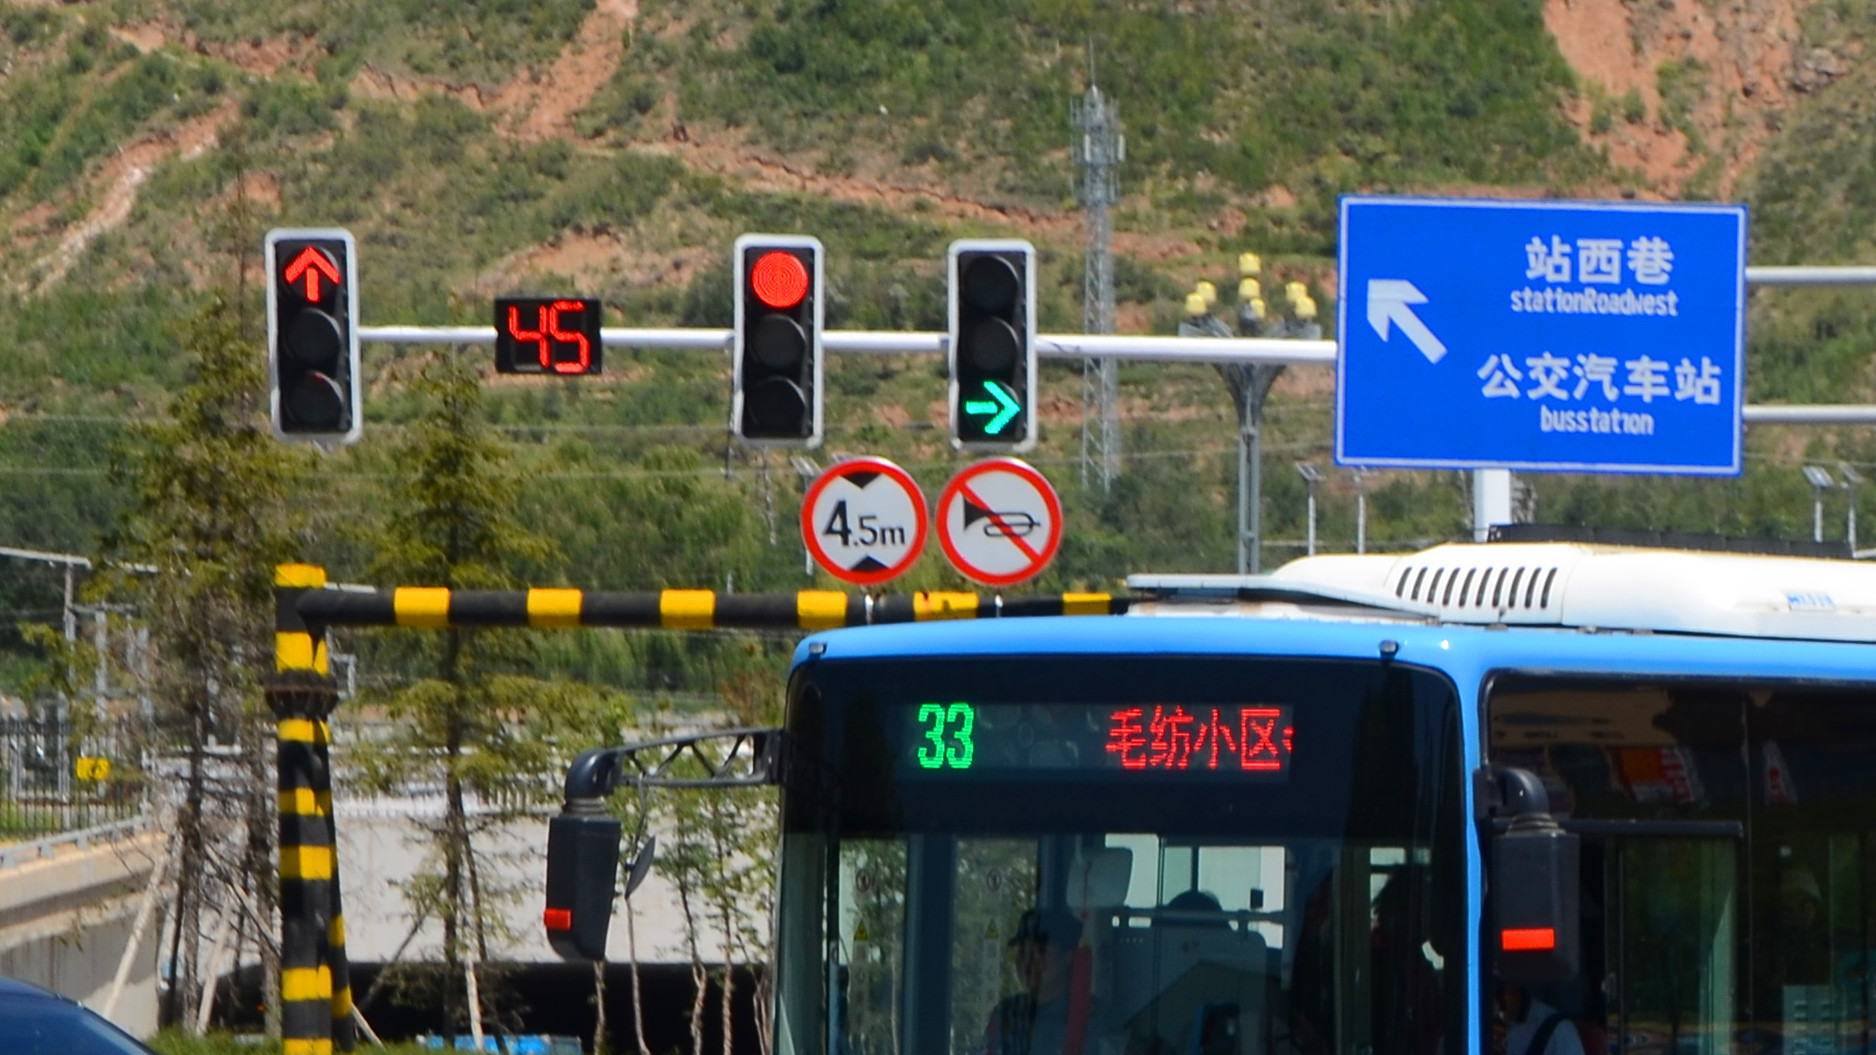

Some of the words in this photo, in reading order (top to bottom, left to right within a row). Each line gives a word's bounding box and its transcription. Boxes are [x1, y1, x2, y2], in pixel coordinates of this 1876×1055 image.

[1525, 235, 1676, 287] 站西巷
[508, 301, 590, 374] 45
[1476, 351, 1723, 406] 公交汽车站
[1540, 405, 1655, 436] busstation
[823, 499, 906, 549] 4.5m
[916, 702, 975, 770] 33
[1105, 704, 1294, 771] 毛纺小区
